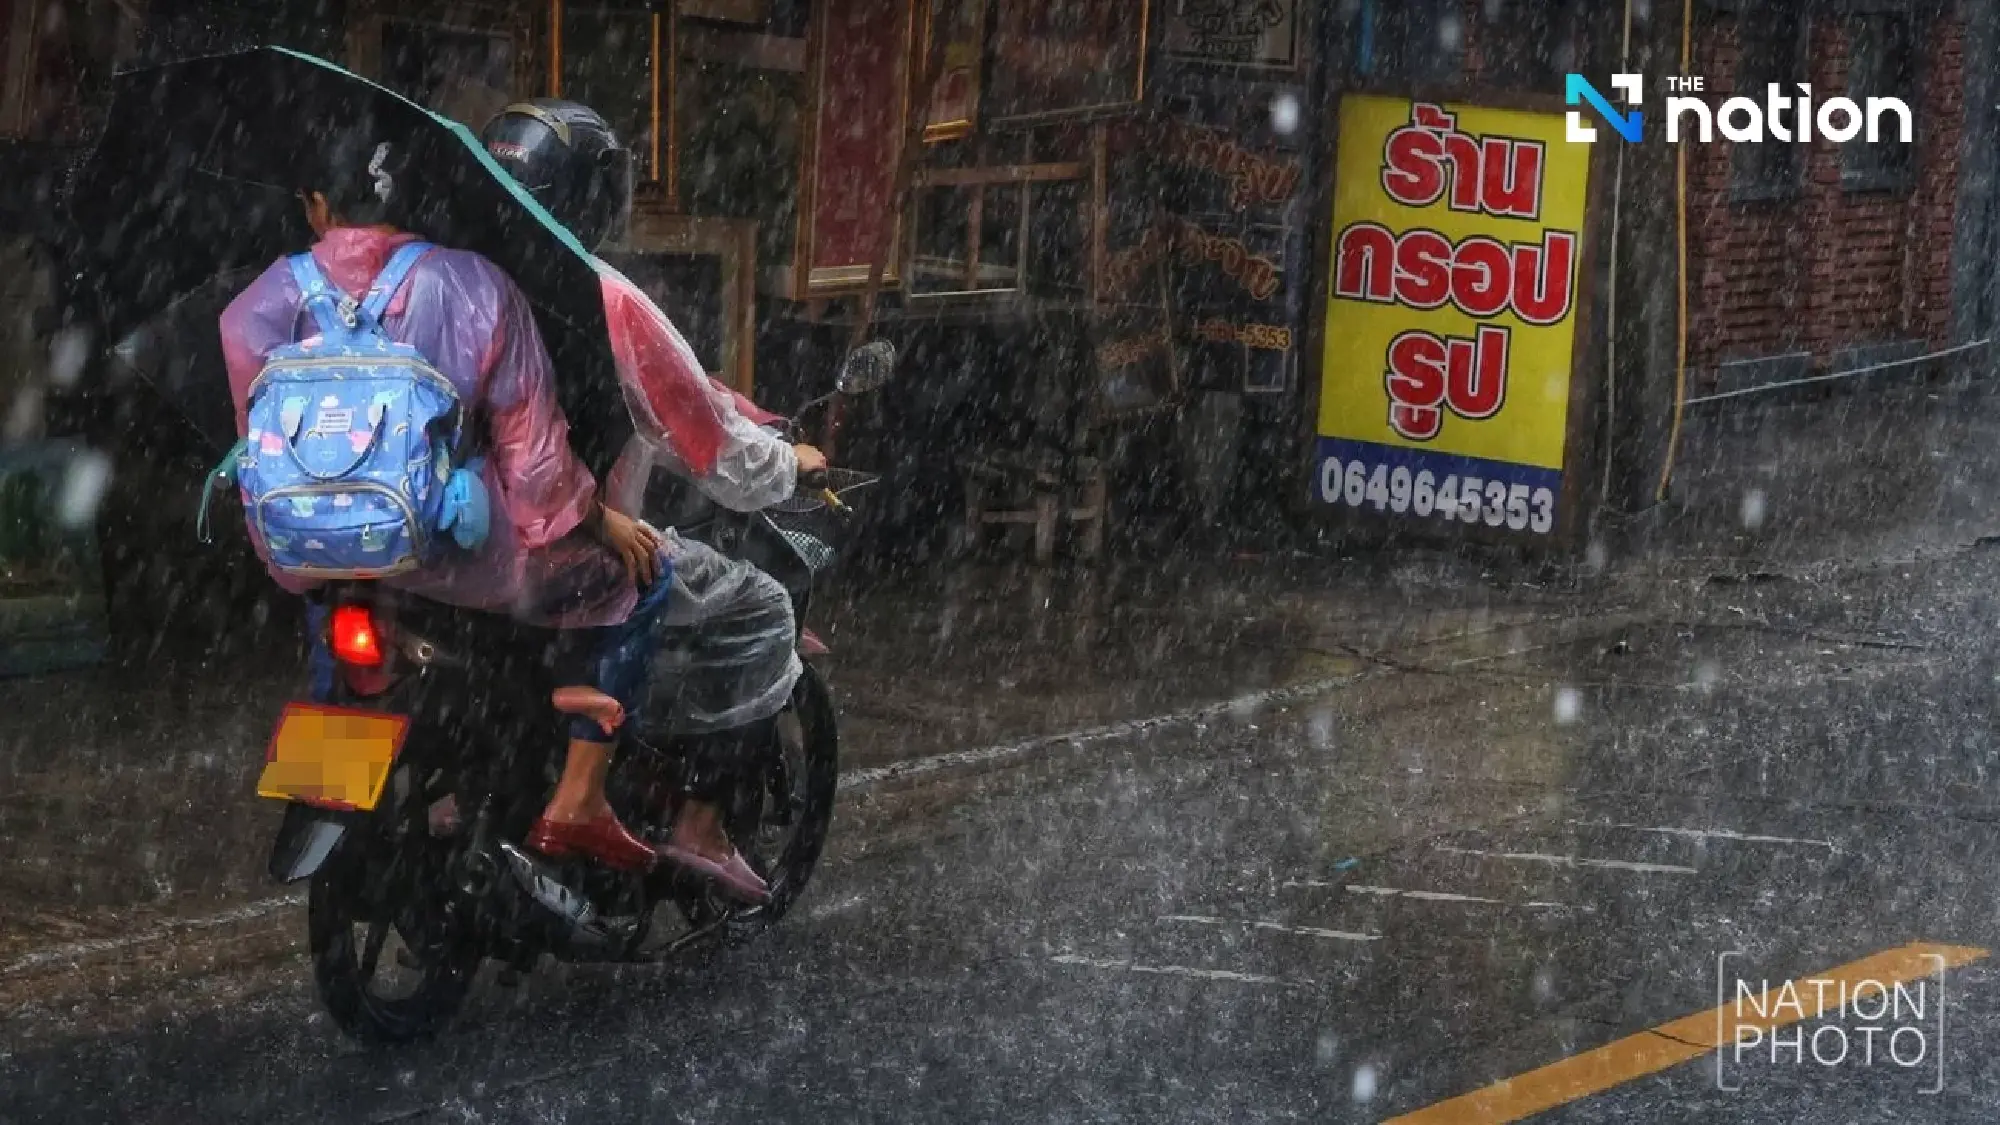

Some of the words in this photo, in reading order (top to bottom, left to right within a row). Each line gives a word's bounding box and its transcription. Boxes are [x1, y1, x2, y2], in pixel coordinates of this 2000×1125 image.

[1383, 101, 1544, 218] ร้าน
[1334, 222, 1576, 323] กรอป
[1386, 326, 1510, 440] รูป
[1321, 456, 1553, 533] 0649645353
